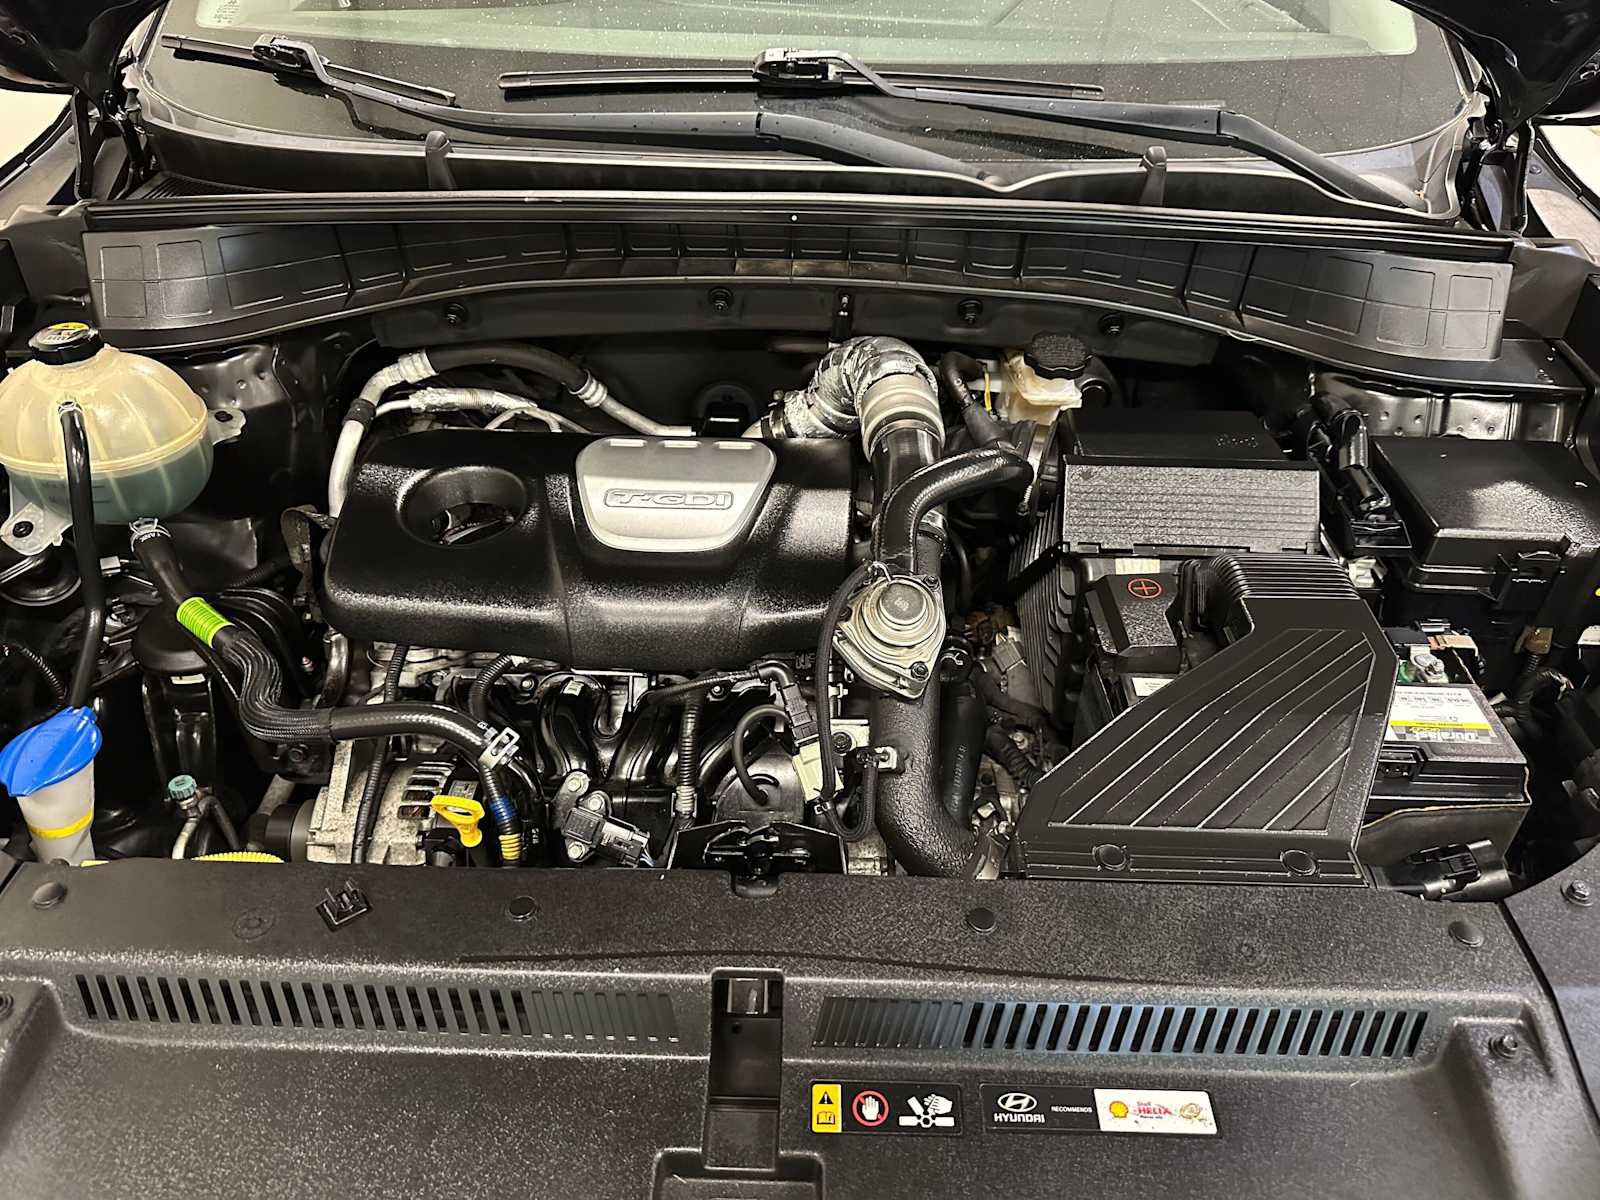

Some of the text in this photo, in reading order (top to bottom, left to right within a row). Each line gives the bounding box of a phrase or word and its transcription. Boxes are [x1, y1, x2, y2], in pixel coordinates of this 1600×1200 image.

[611, 492, 727, 506] T-GDI
[1051, 1105, 1093, 1113] RECOMMENDS
[1137, 1106, 1172, 1115] HELIX
[994, 1113, 1046, 1123] HYUNDAI
